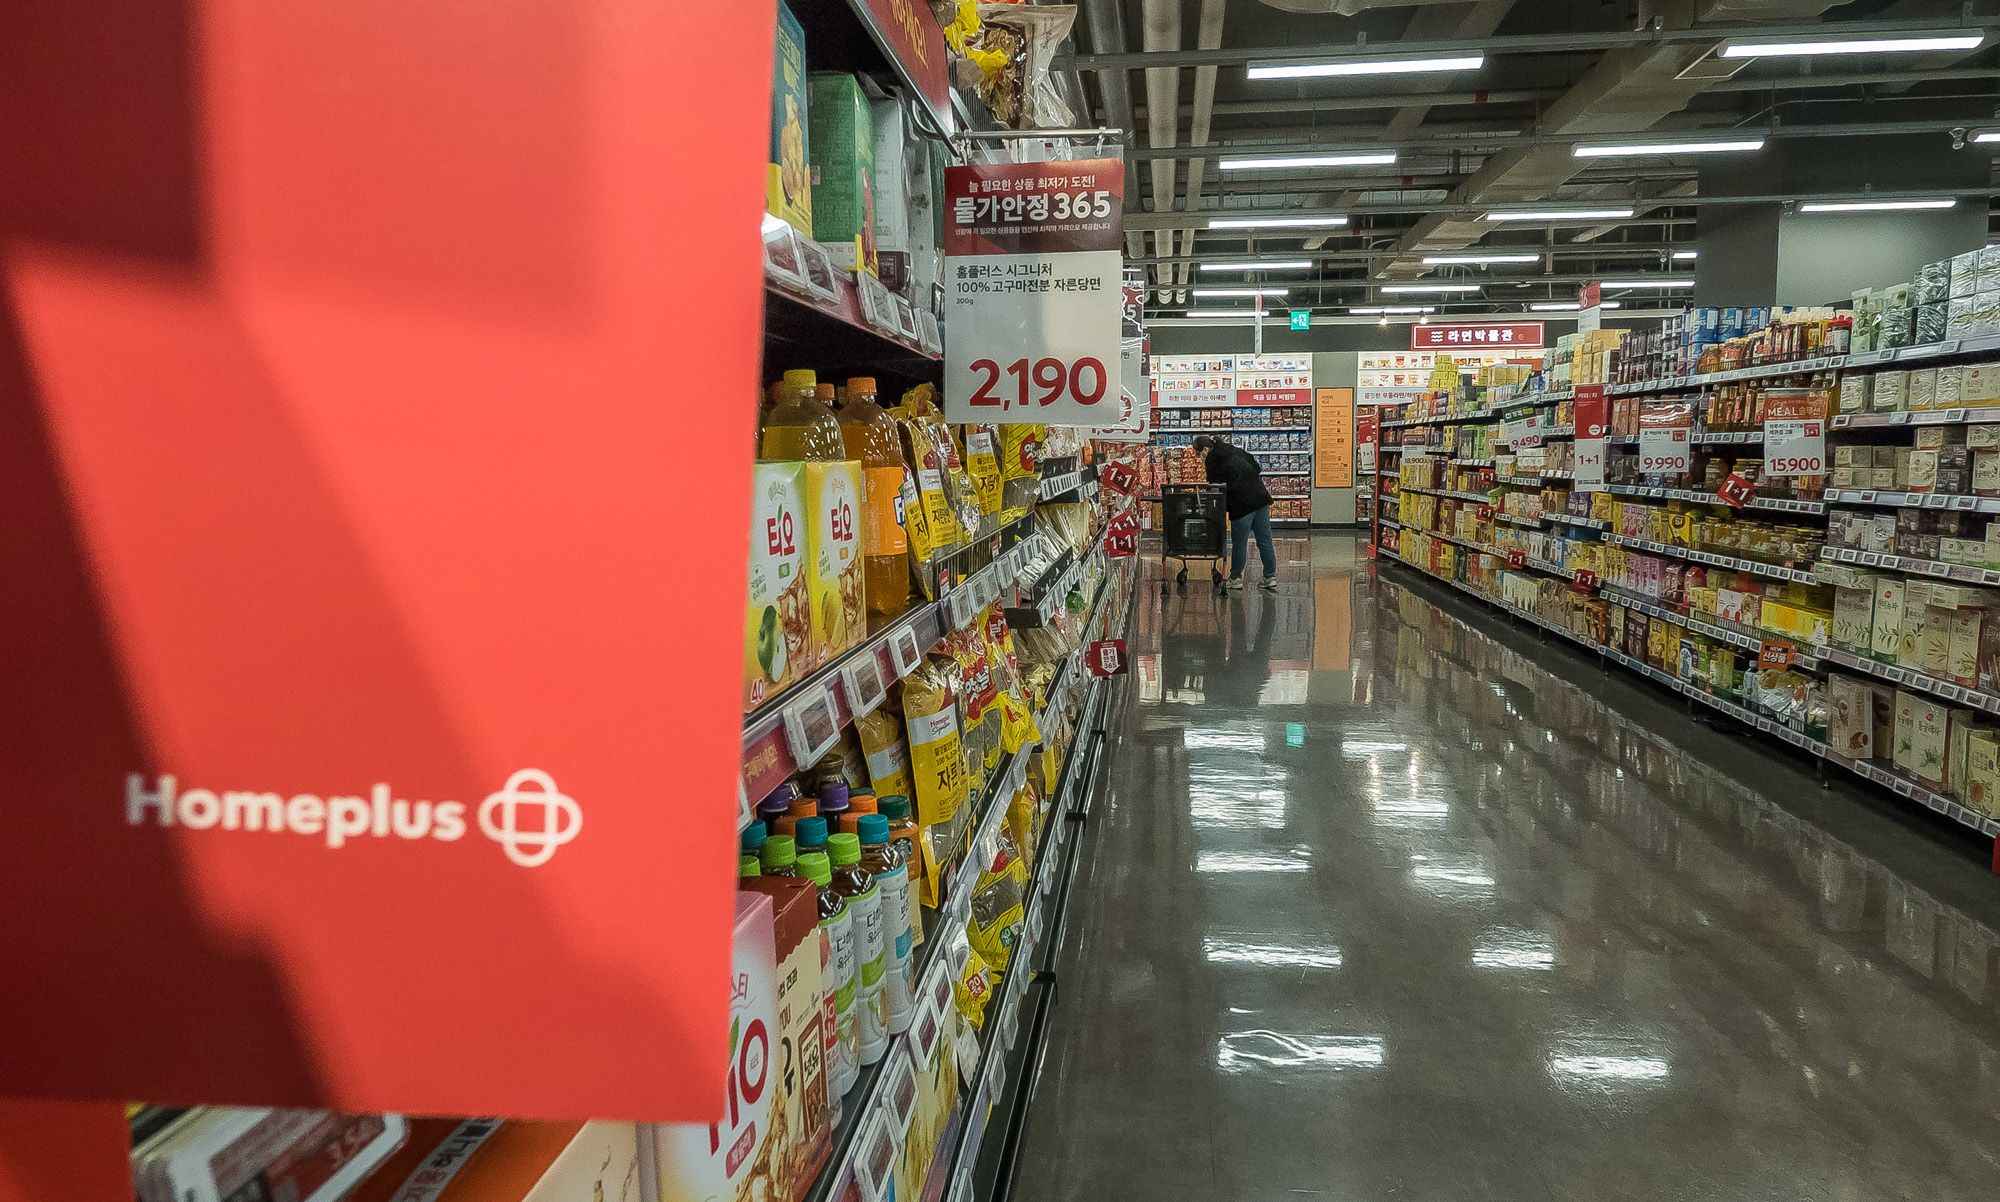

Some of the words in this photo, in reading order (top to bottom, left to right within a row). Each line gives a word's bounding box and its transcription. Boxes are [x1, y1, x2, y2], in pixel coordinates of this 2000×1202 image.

[969, 181, 979, 193] 늘
[982, 179, 1011, 192] 필요한
[1014, 178, 1035, 191] 상품
[1038, 176, 1068, 189] 최저가
[1071, 175, 1095, 188] 도전!
[956, 264, 1003, 279] 홈플러스
[1006, 262, 1053, 277] 시그니처
[1053, 276, 1101, 291] 자른당면
[956, 297, 974, 306] 300g
[1580, 290, 1588, 309] 16
[1448, 329, 1514, 342] 라면박물관
[968, 356, 1107, 412] 2,190
[1767, 406, 1799, 417] MEAL
[1578, 454, 1599, 465] 1+1
[1643, 456, 1685, 470] 9,990
[1769, 457, 1821, 474] 15,900
[1110, 467, 1133, 488] 1+1
[1479, 472, 1494, 481] 1+1
[1724, 480, 1749, 501] 1+1
[1478, 507, 1492, 517] 1+1
[1114, 515, 1136, 531] 1+1
[1110, 534, 1132, 550] 1+1
[1508, 555, 1523, 565] 1+1
[1575, 573, 1594, 586] 1+1
[1763, 652, 1787, 664] 신상품
[125, 773, 467, 850] Homeplus
